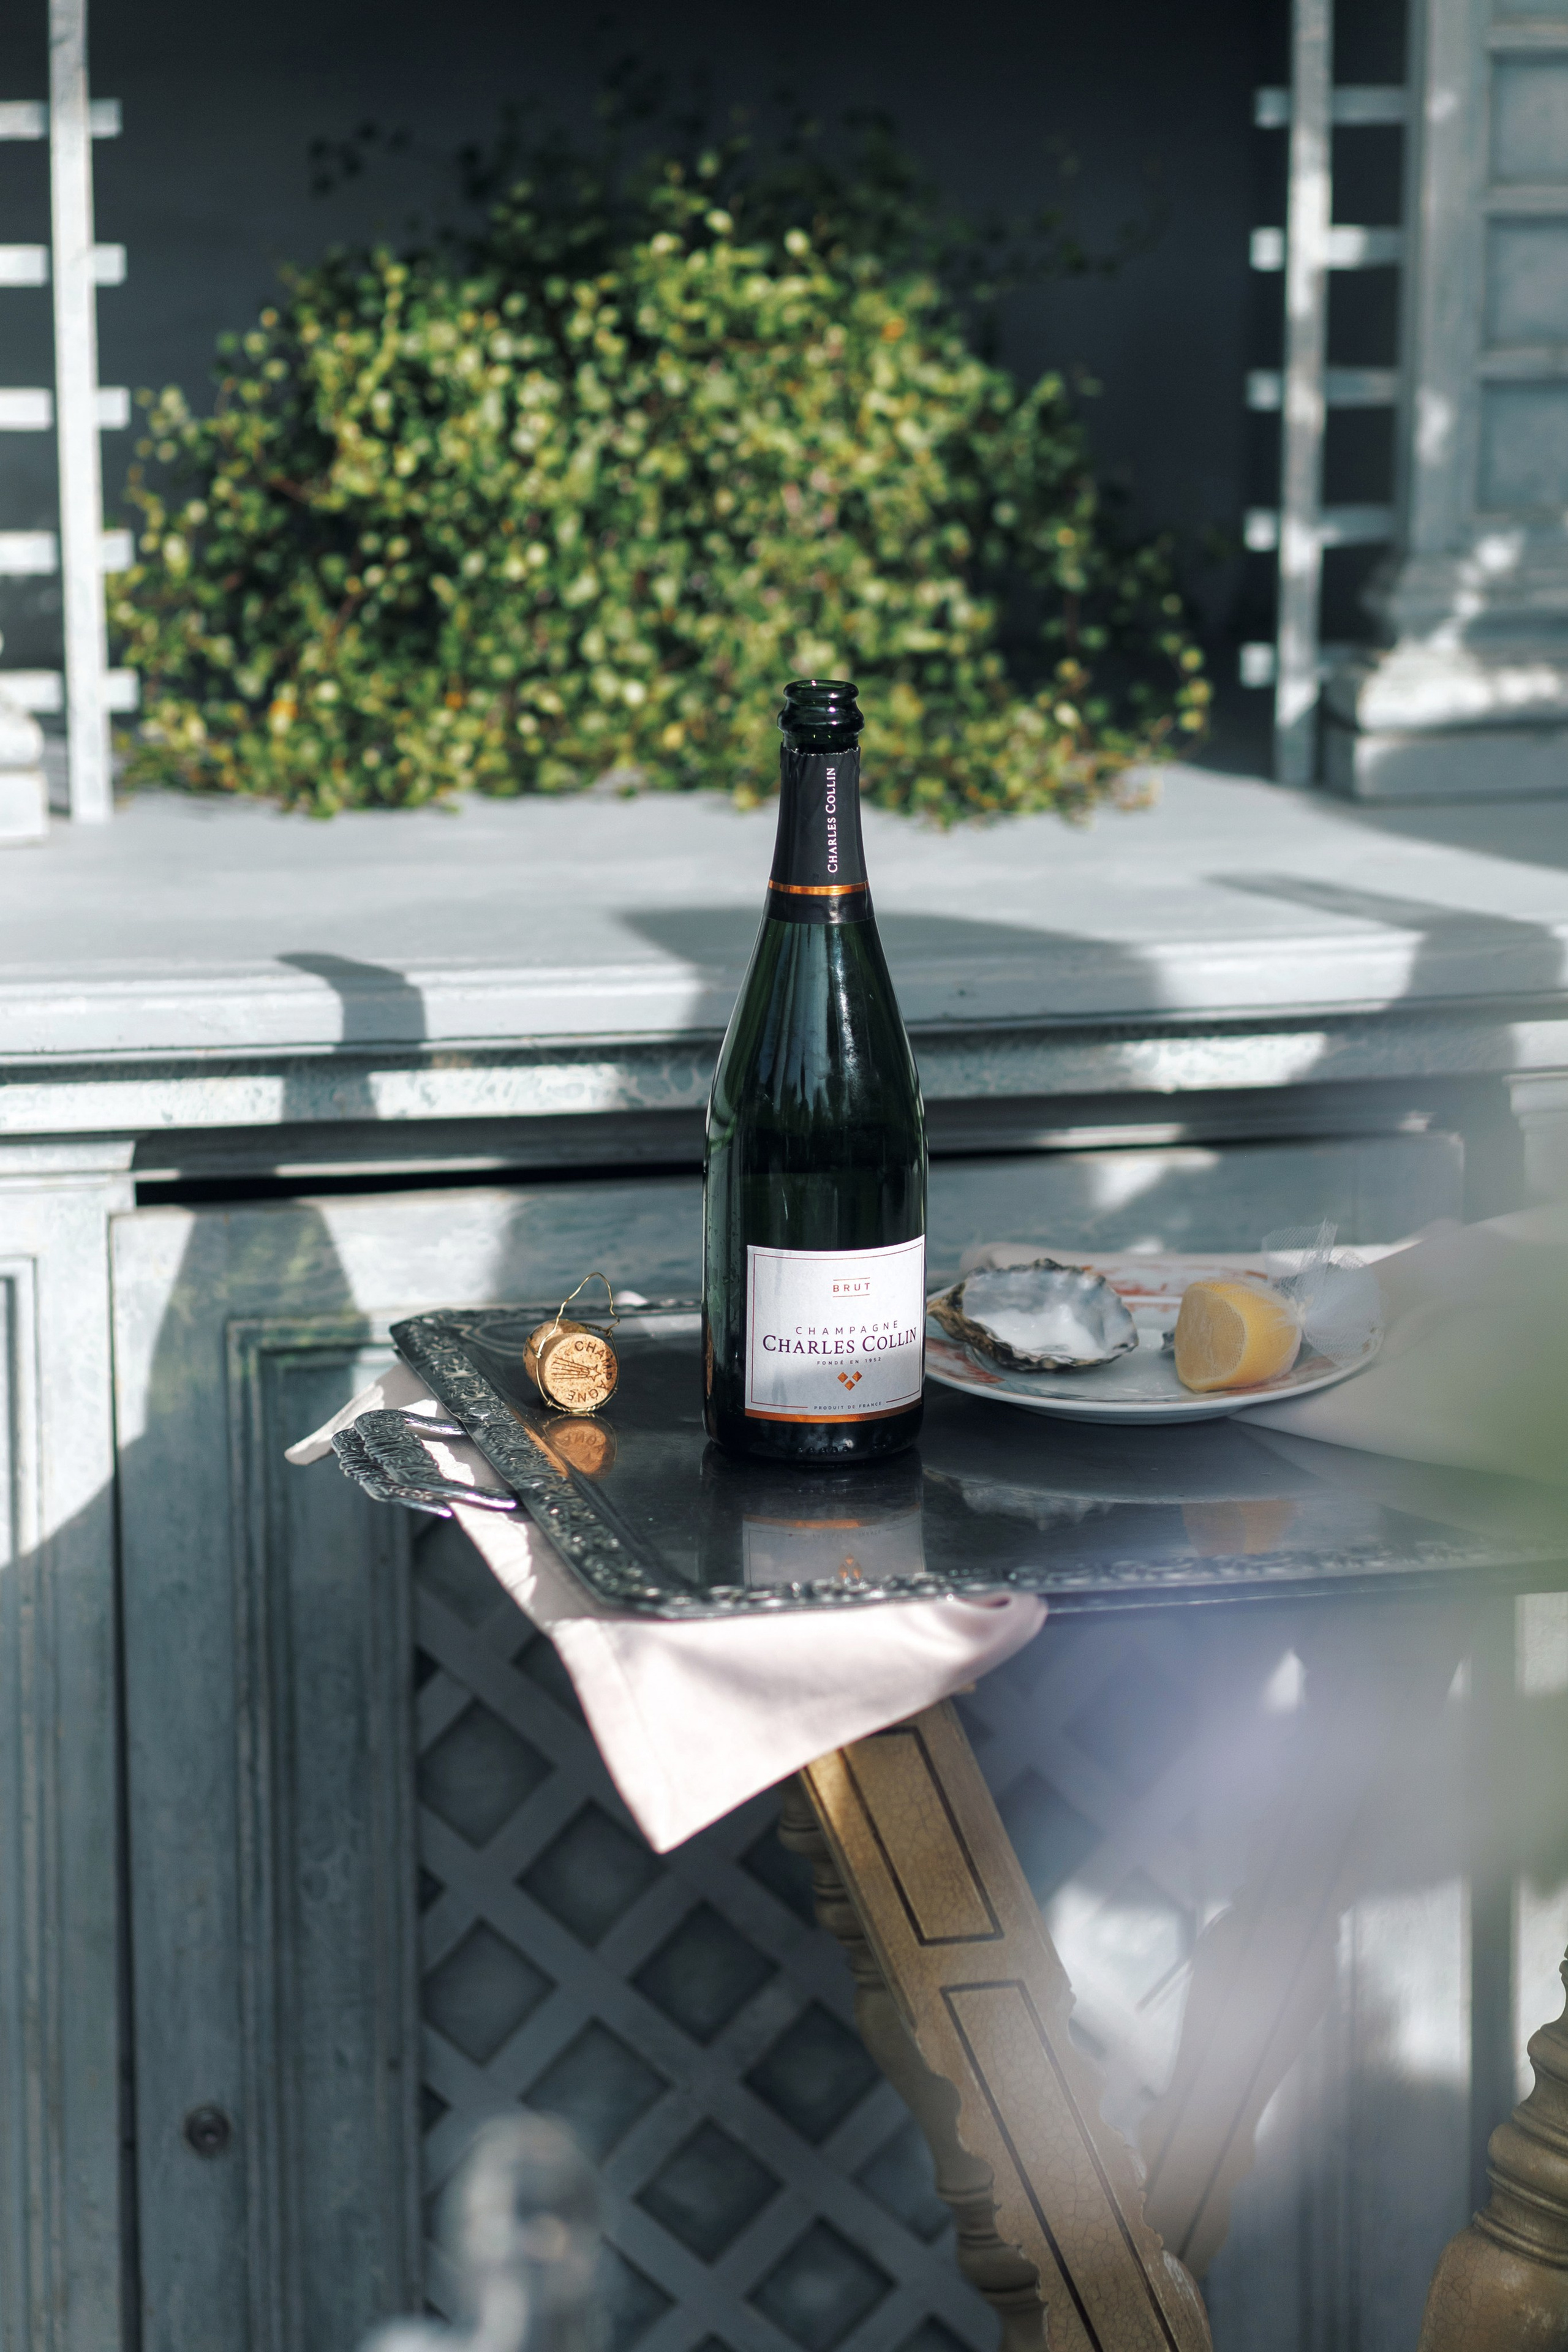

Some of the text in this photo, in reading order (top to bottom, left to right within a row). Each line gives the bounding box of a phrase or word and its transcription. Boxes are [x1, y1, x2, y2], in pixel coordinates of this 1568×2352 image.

[825, 767, 838, 873] CHARLES COLLIN
[832, 1282, 870, 1292] BRUT
[796, 1320, 899, 1335] CHAMPAGNE
[763, 1327, 917, 1354] CHARLES COLLIN
